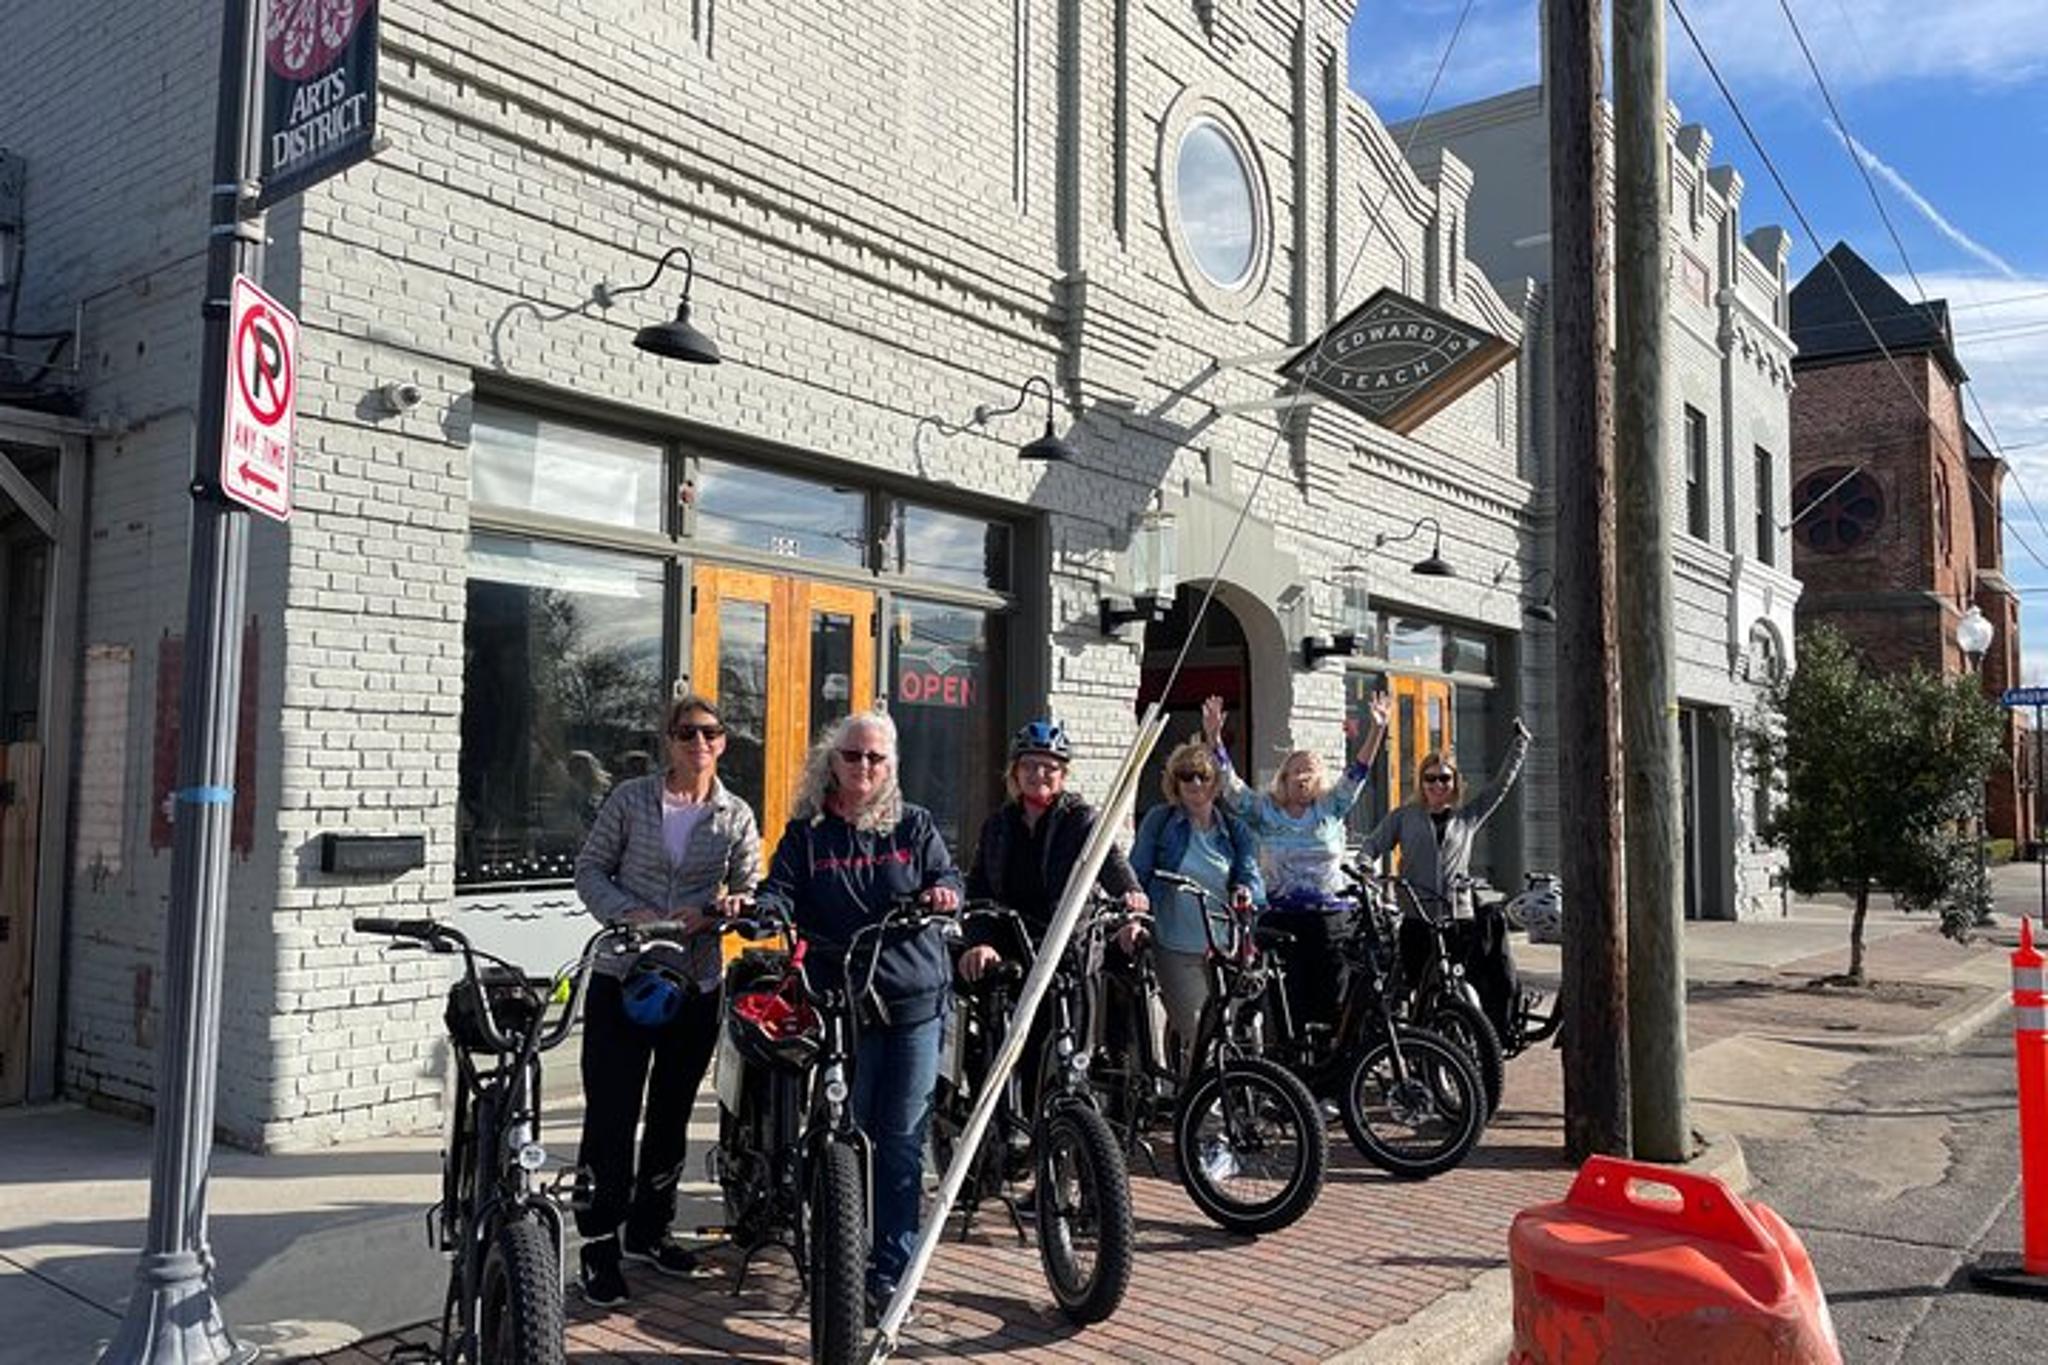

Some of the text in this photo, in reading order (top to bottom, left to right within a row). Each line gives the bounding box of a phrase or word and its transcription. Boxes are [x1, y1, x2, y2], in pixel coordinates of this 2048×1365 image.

[289, 67, 346, 125] ARTS
[271, 90, 368, 169] DISTRICT
[1335, 322, 1438, 354] EDWARD
[252, 324, 282, 399] P
[1340, 360, 1431, 389] TEACH
[233, 421, 257, 456] ANY
[901, 671, 977, 706] OPEN
